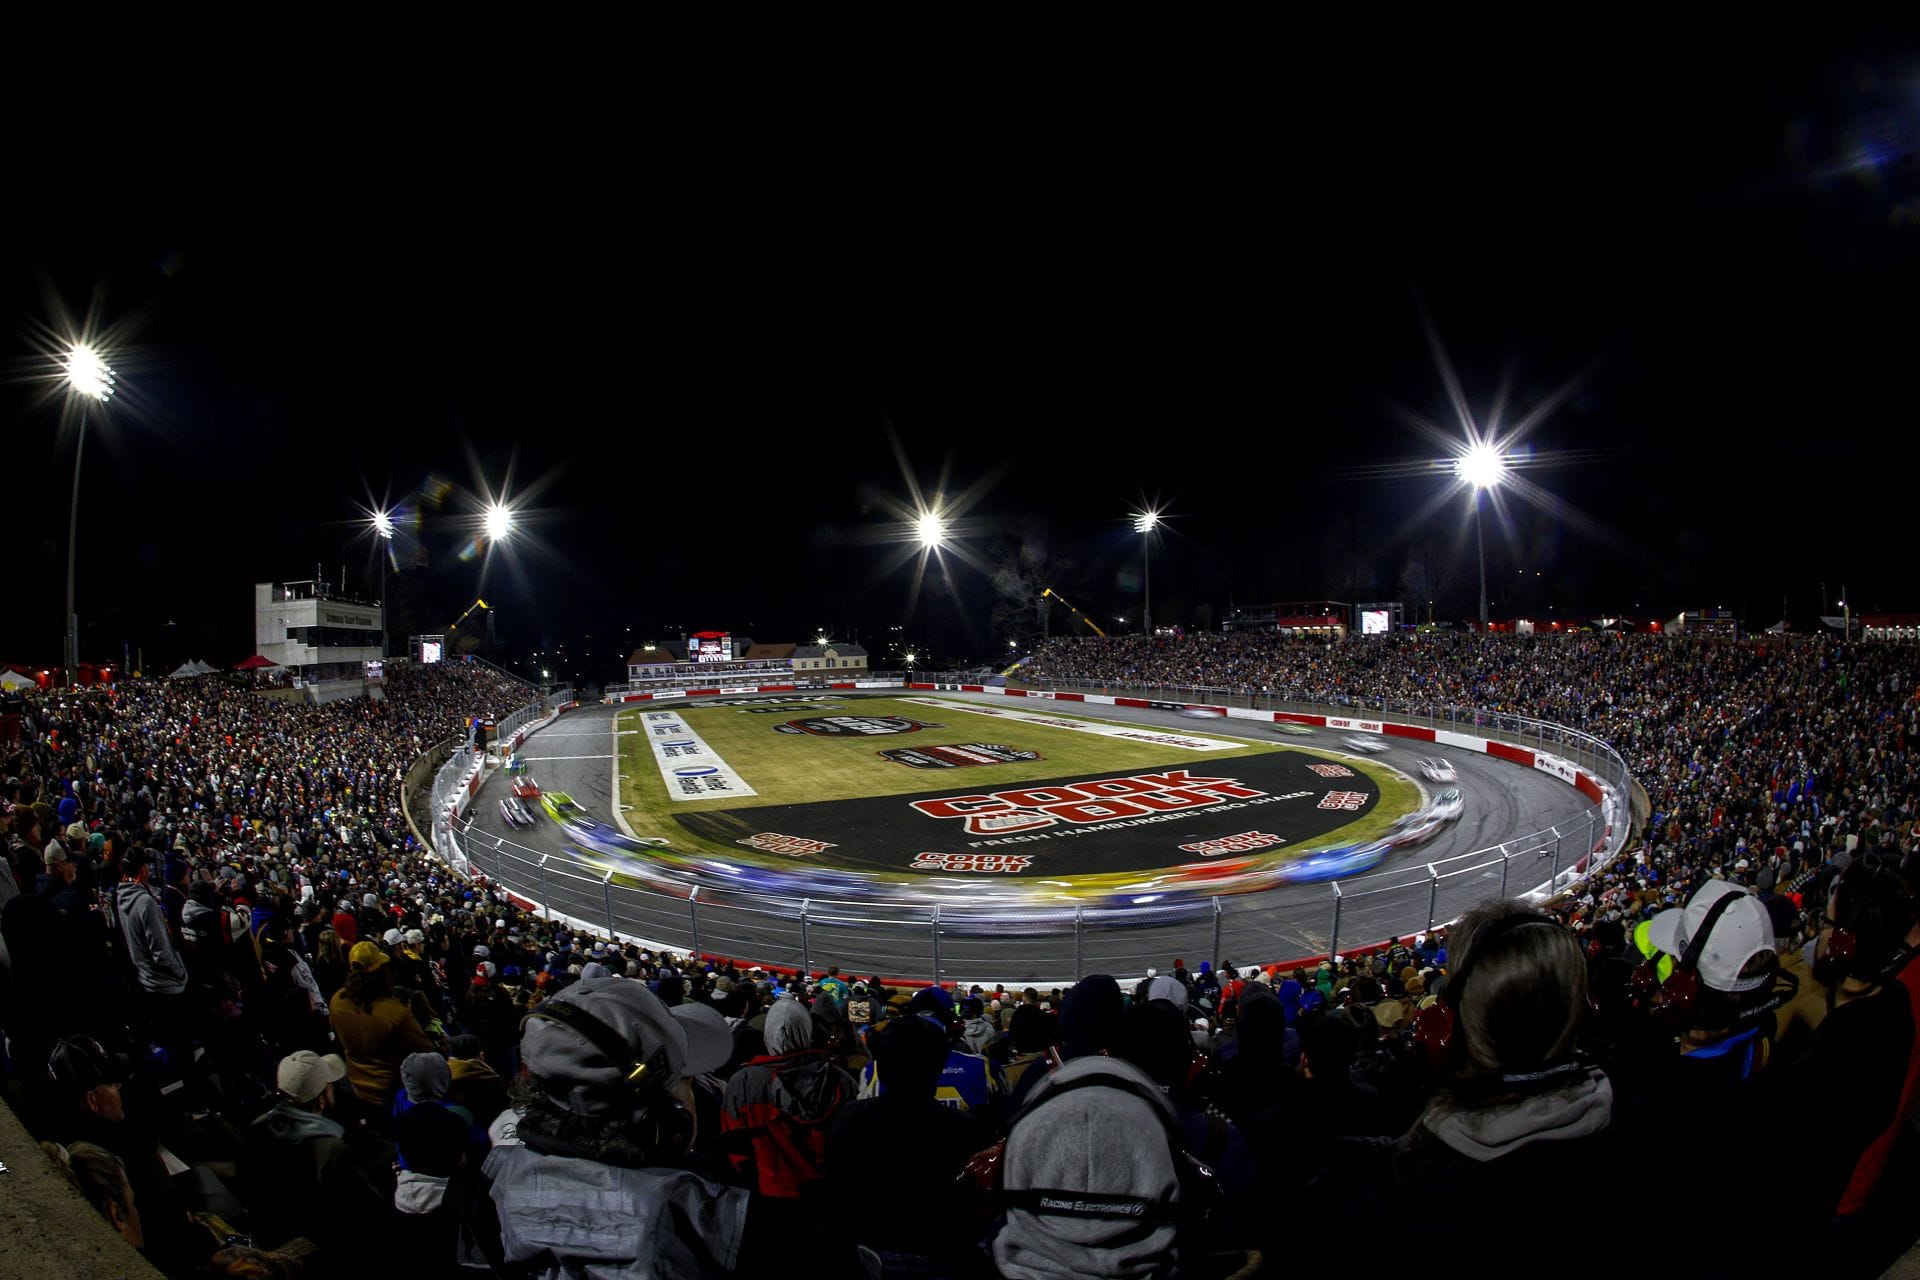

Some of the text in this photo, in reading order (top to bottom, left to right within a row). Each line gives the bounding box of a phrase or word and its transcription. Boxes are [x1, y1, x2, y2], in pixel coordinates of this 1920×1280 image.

[909, 769, 1238, 819] COOK
[1037, 780, 1270, 824] OUT
[968, 791, 1315, 848] FRESH HAMBURGERS BBQ SHAKES
[750, 832, 839, 853] COOK
[752, 841, 818, 857] OUT
[1177, 830, 1280, 852] COOK
[1220, 834, 1287, 852] OUT
[914, 852, 1035, 864] COOK
[942, 860, 1030, 873] OUT
